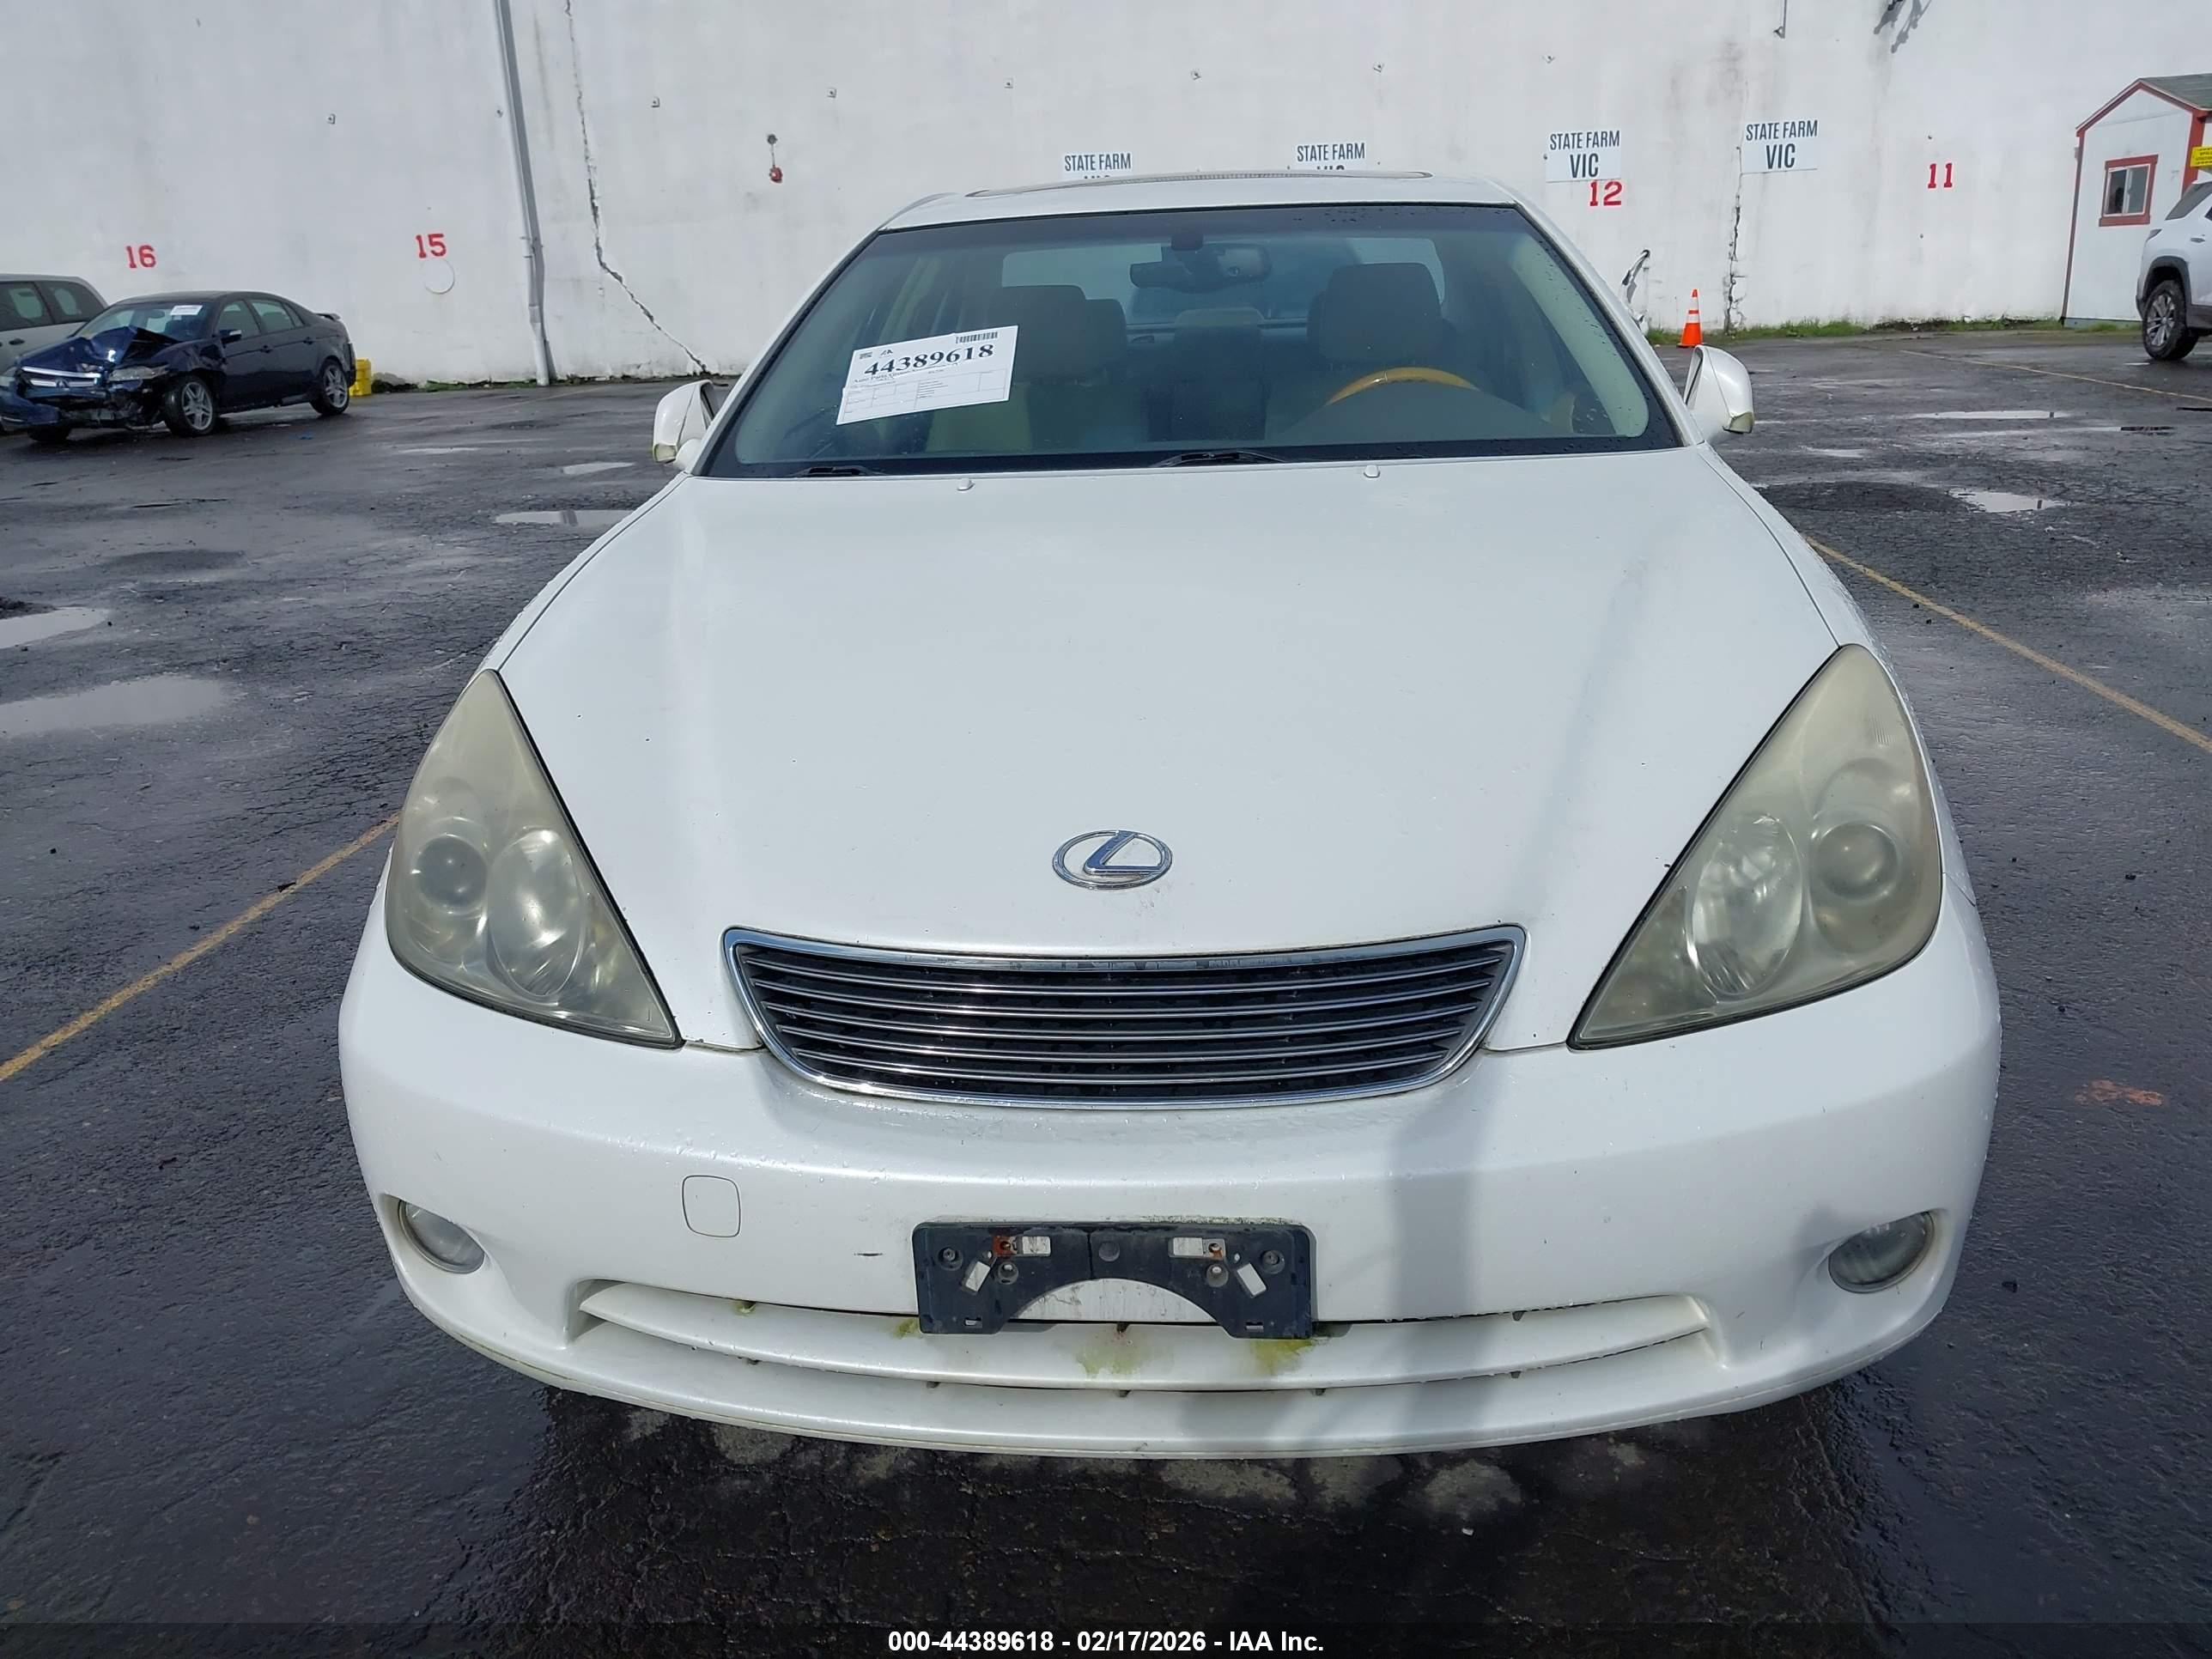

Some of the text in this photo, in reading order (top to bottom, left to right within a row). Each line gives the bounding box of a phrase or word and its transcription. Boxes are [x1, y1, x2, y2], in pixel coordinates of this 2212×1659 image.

[1549, 130, 1620, 150] STATE FARM
[1746, 119, 1819, 142] STATE FARM
[1064, 152, 1132, 172] STATE FARM
[1297, 142, 1365, 161] STATE FARM
[1765, 143, 1796, 170] VIC
[1569, 153, 1599, 179] VIC
[1927, 162, 1954, 190] 11
[1589, 180, 1623, 207] 12
[126, 244, 156, 269] 16
[415, 233, 447, 259] 15
[864, 343, 994, 375] 44389618
